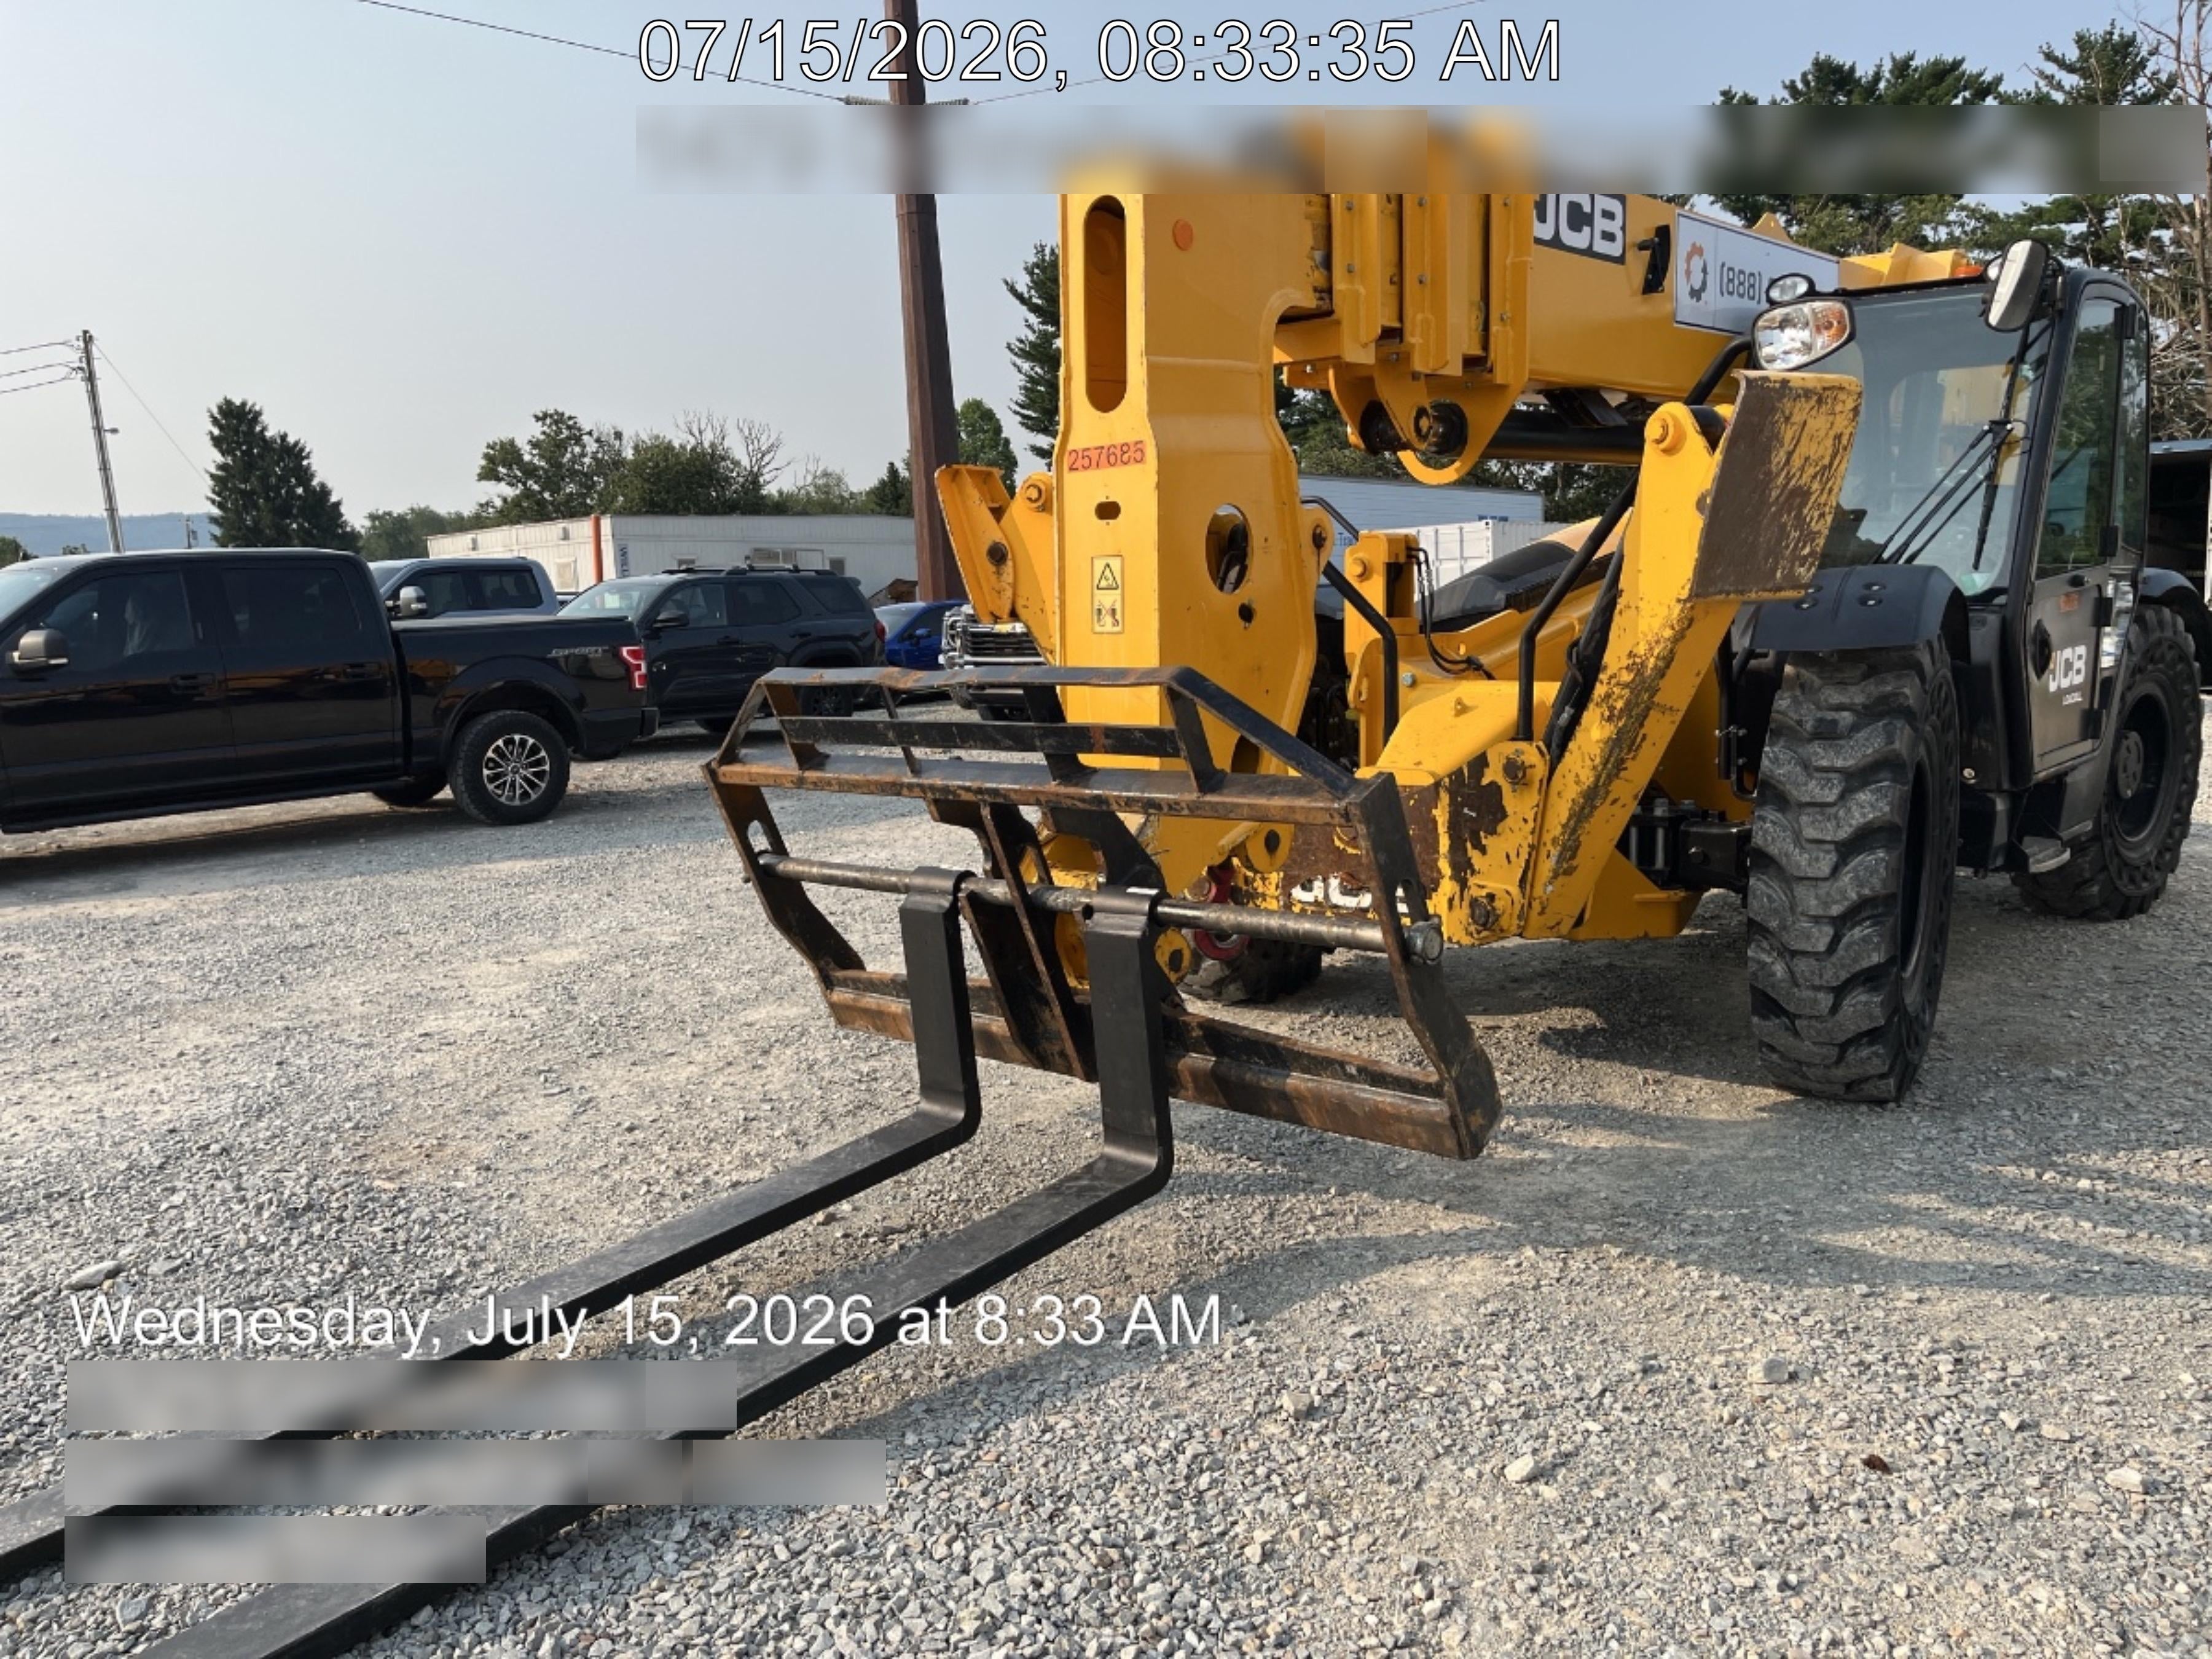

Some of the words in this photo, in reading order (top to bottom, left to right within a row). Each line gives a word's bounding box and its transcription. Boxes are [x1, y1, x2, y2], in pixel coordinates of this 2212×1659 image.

[1534, 194, 1623, 256] JCB
[1720, 261, 1762, 305] (888)
[1069, 441, 1143, 471] 257685
[2049, 645, 2087, 692] JCB
